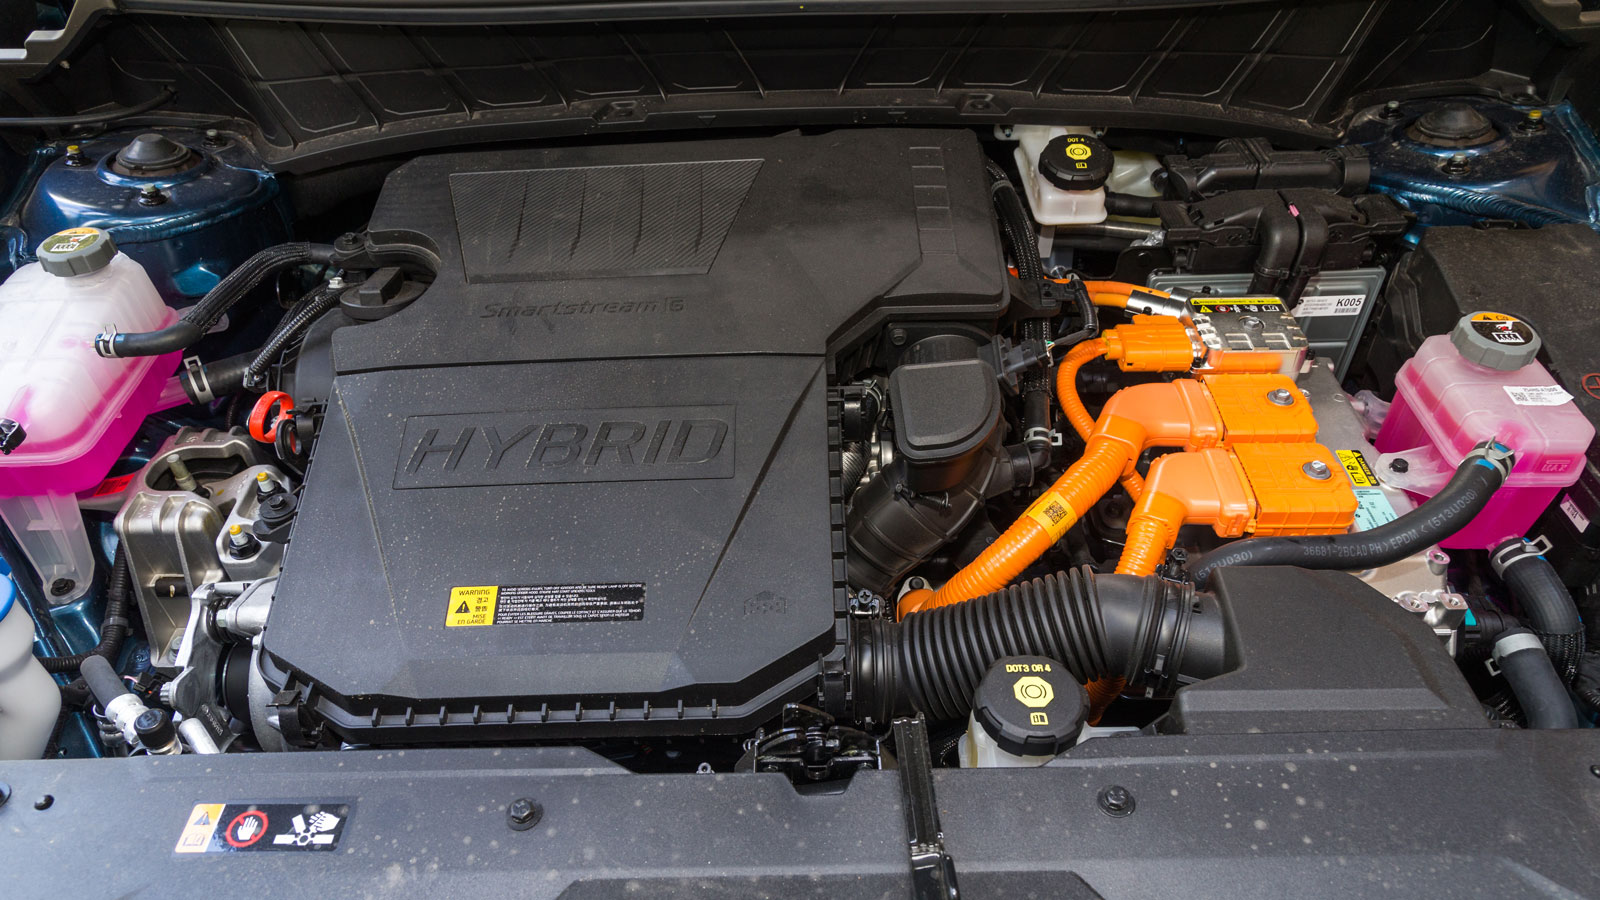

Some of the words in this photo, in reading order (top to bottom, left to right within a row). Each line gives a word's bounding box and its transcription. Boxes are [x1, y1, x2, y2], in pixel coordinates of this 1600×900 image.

[480, 300, 658, 319] Smartstream
[1336, 298, 1362, 307] K005
[405, 419, 729, 474] HYBRID
[1389, 528, 1419, 549] EPDM
[1005, 664, 1030, 672] DOT3
[1031, 664, 1044, 672] OR
[1044, 664, 1052, 672] 4
